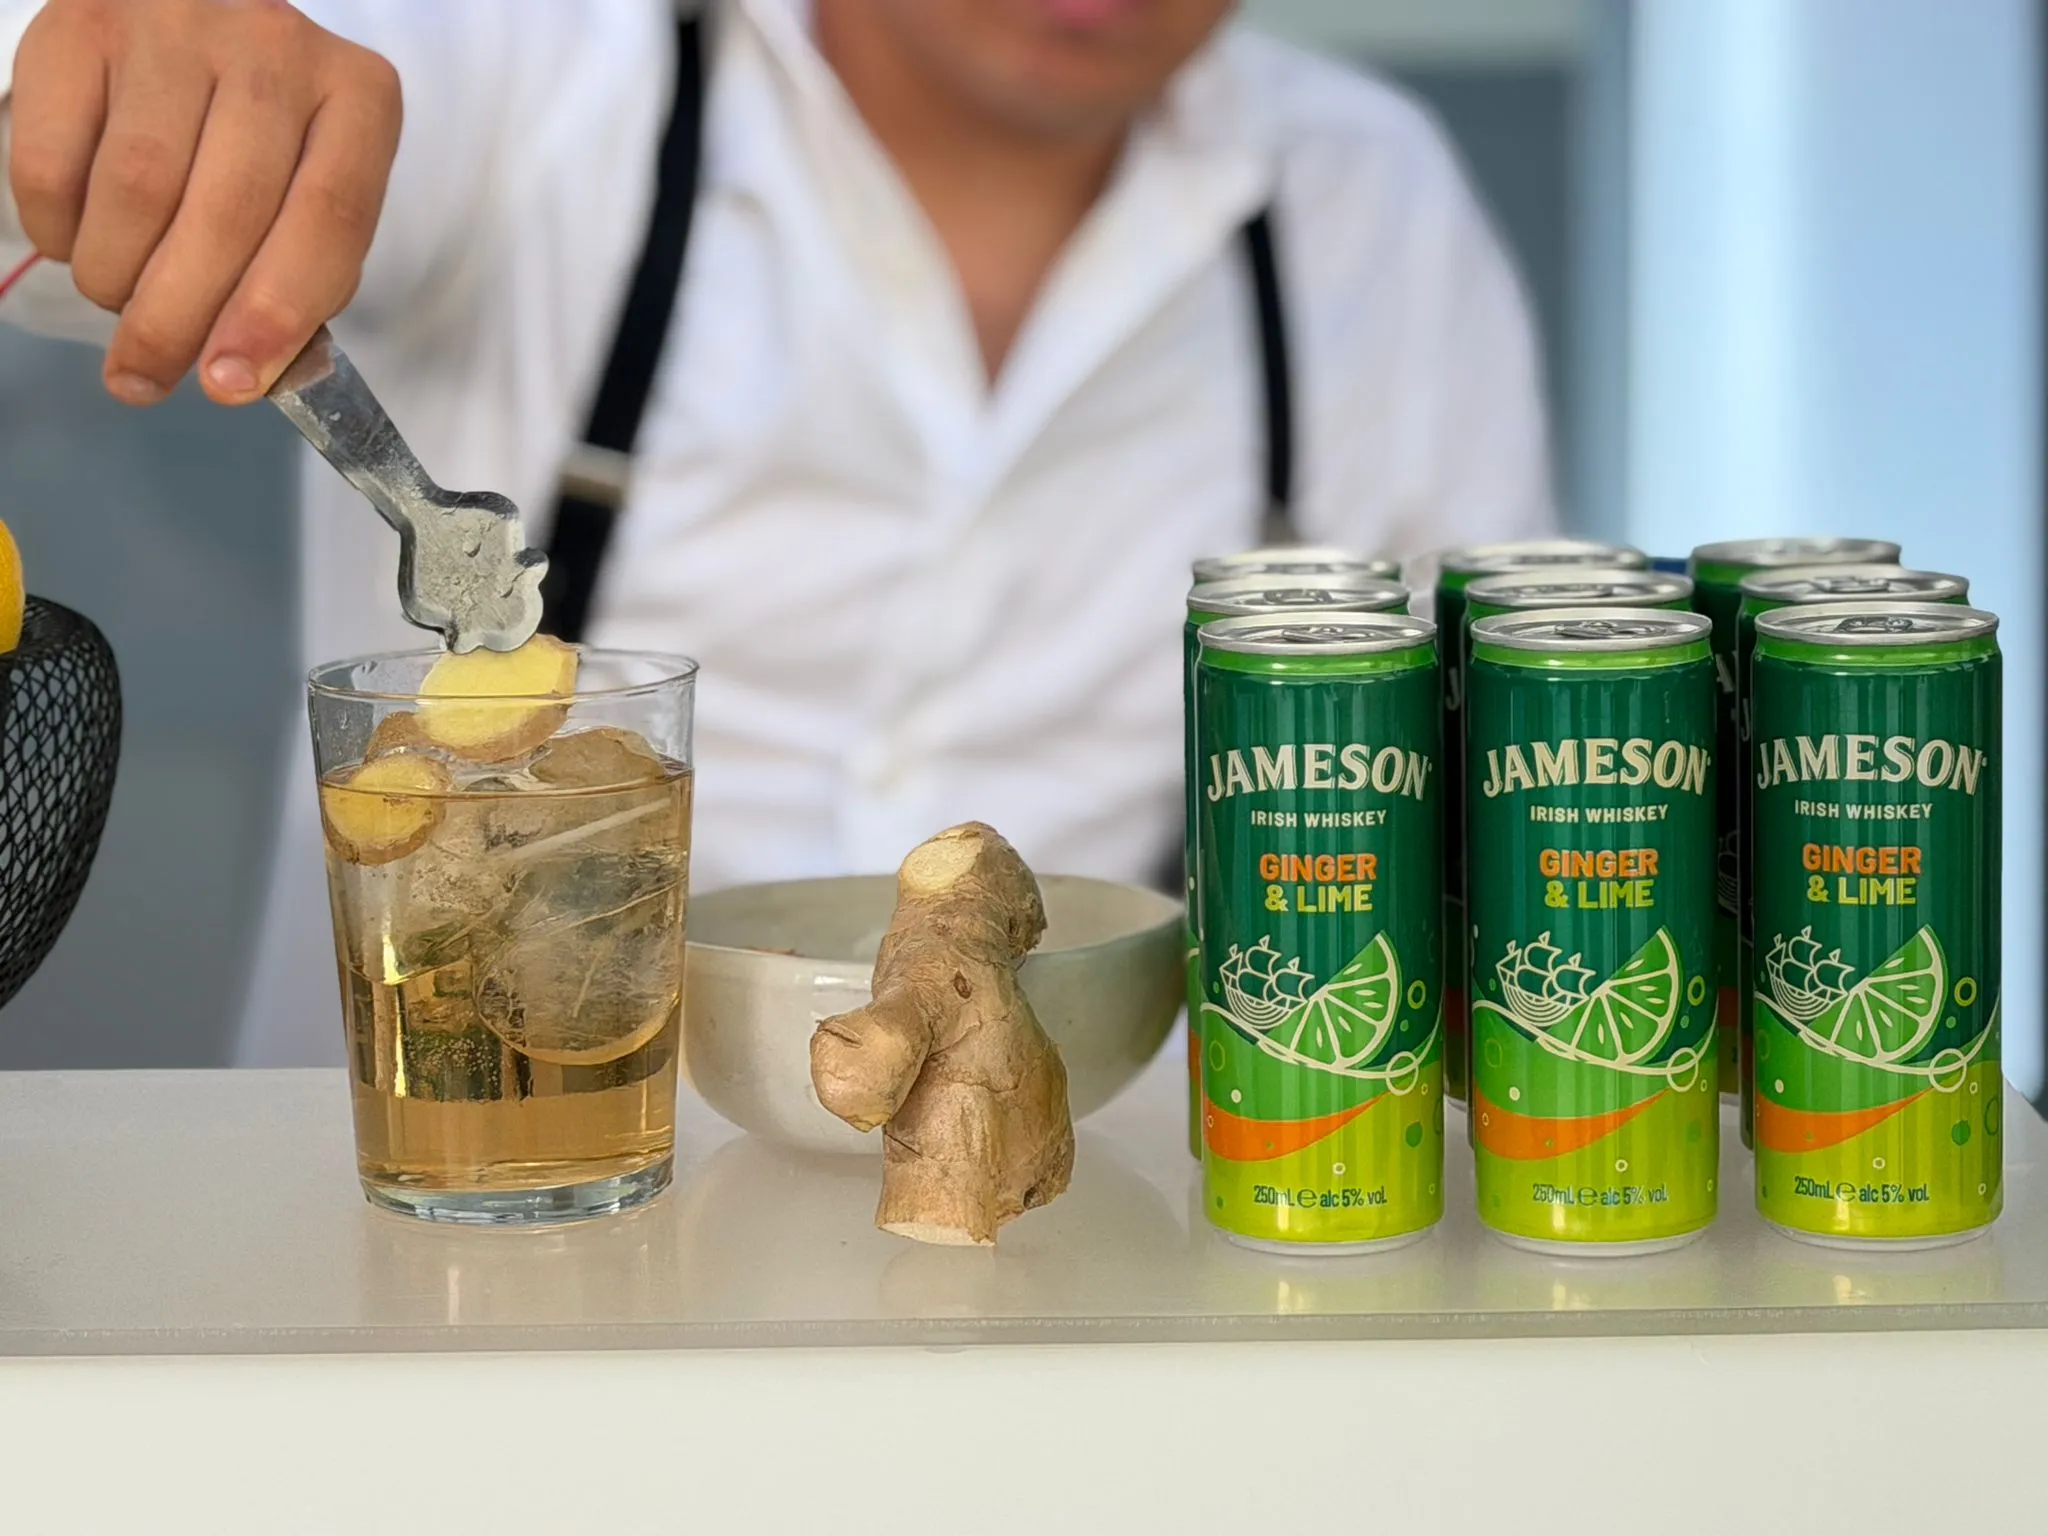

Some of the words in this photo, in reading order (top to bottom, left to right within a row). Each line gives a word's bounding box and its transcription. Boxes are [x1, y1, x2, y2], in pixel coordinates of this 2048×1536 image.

[1207, 743, 1428, 802] JAMESON
[1483, 738, 1708, 798] JAMESON
[1757, 734, 1983, 796] JAMESON
[1251, 810, 1297, 827] IRISH
[1304, 809, 1387, 828] WHISKEY
[1530, 805, 1579, 823] IRISH
[1585, 804, 1668, 823] WHISKEY
[1795, 800, 1840, 818] IRISH
[1846, 803, 1933, 820] WHISKEY
[1259, 853, 1378, 882] GINGER
[1539, 848, 1659, 878] GINGER
[1803, 843, 1922, 875] GINGER
[1264, 884, 1289, 912] &
[1297, 884, 1373, 913] LIME
[1544, 880, 1570, 908] &
[1577, 879, 1655, 909] LIME
[1807, 874, 1830, 903] &
[1838, 876, 1917, 905] LIME
[1319, 1188, 1339, 1208] alc
[1342, 1188, 1364, 1208] 5%
[1600, 1186, 1620, 1206] alc
[1623, 1186, 1645, 1205] 5%
[1859, 1183, 1879, 1203] alc
[1881, 1183, 1904, 1203] 5%
